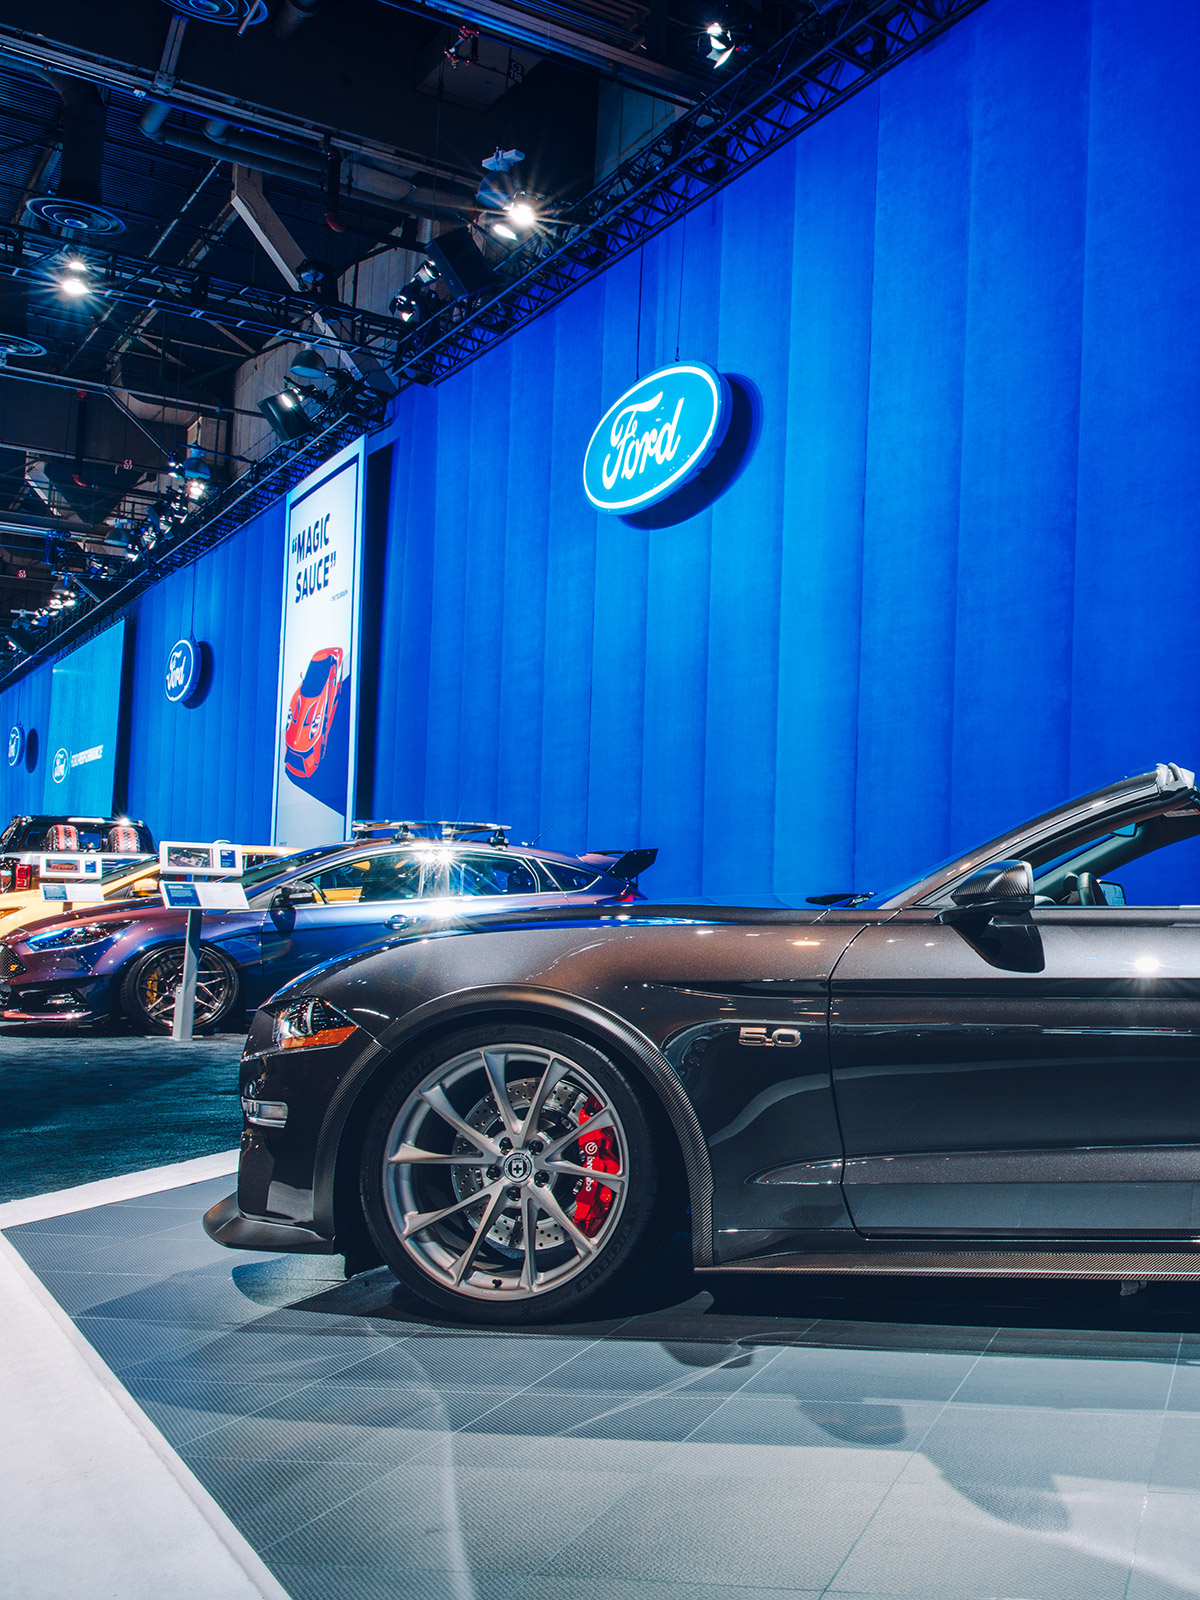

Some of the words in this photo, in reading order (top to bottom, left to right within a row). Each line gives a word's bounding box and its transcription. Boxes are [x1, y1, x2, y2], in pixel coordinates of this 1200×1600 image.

[509, 70, 523, 83] 118
[511, 61, 522, 73] C3
[602, 391, 684, 489] Ford
[166, 650, 186, 690] Ford
[739, 1026, 802, 1048] 5.0
[585, 1156, 595, 1192] brbo
